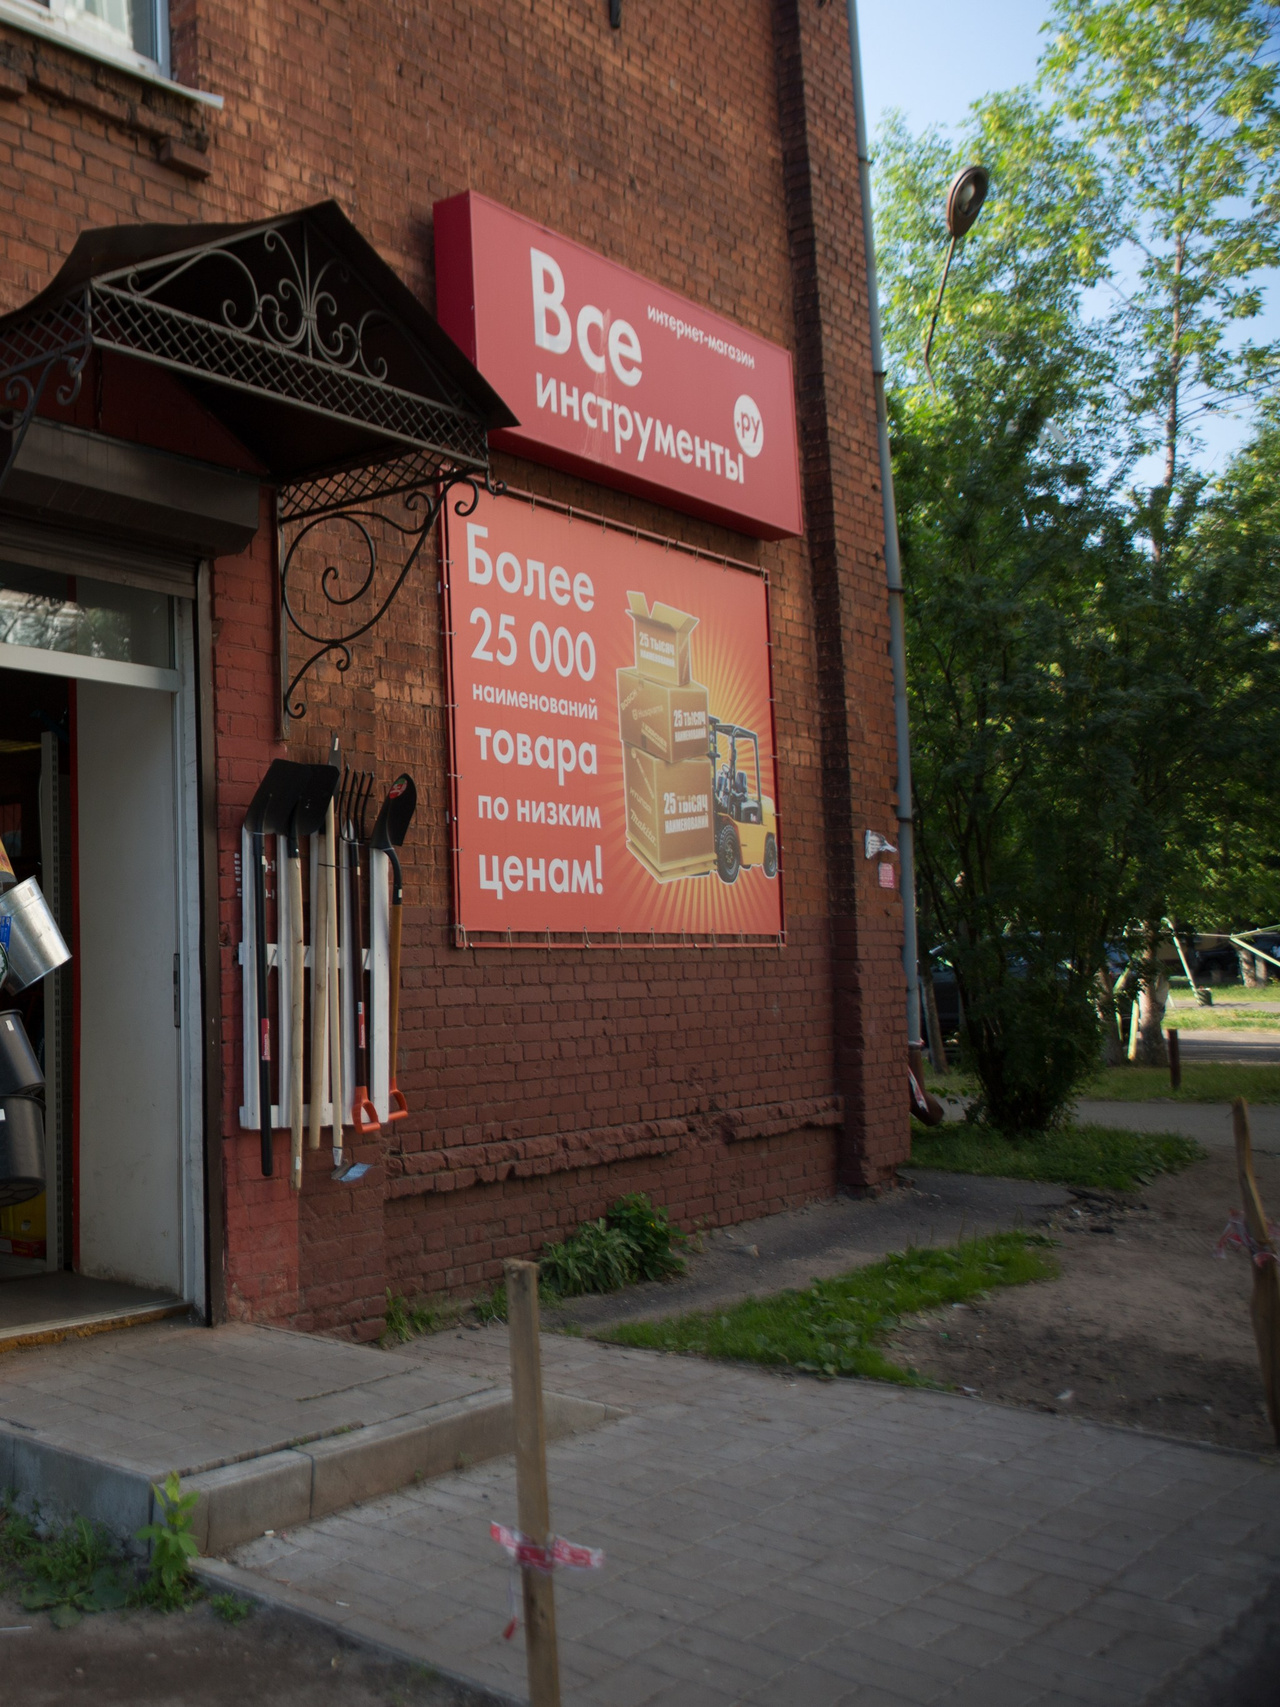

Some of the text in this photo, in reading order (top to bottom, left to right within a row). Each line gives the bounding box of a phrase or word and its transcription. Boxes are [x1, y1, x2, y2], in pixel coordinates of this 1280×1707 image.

[530, 246, 643, 387] Все
[647, 305, 755, 369] интернет-магазин
[535, 371, 745, 484] инструменты
[466, 522, 595, 612] Более
[469, 606, 597, 682] 25 000
[639, 631, 675, 655] 25 ТЫСЯЧ
[472, 682, 598, 721] наименований
[673, 709, 706, 728] 25 ТЫСЯЧ
[475, 725, 598, 786] товара
[478, 794, 601, 829] по низким
[663, 792, 676, 815] 25
[478, 844, 604, 900] ценам!
